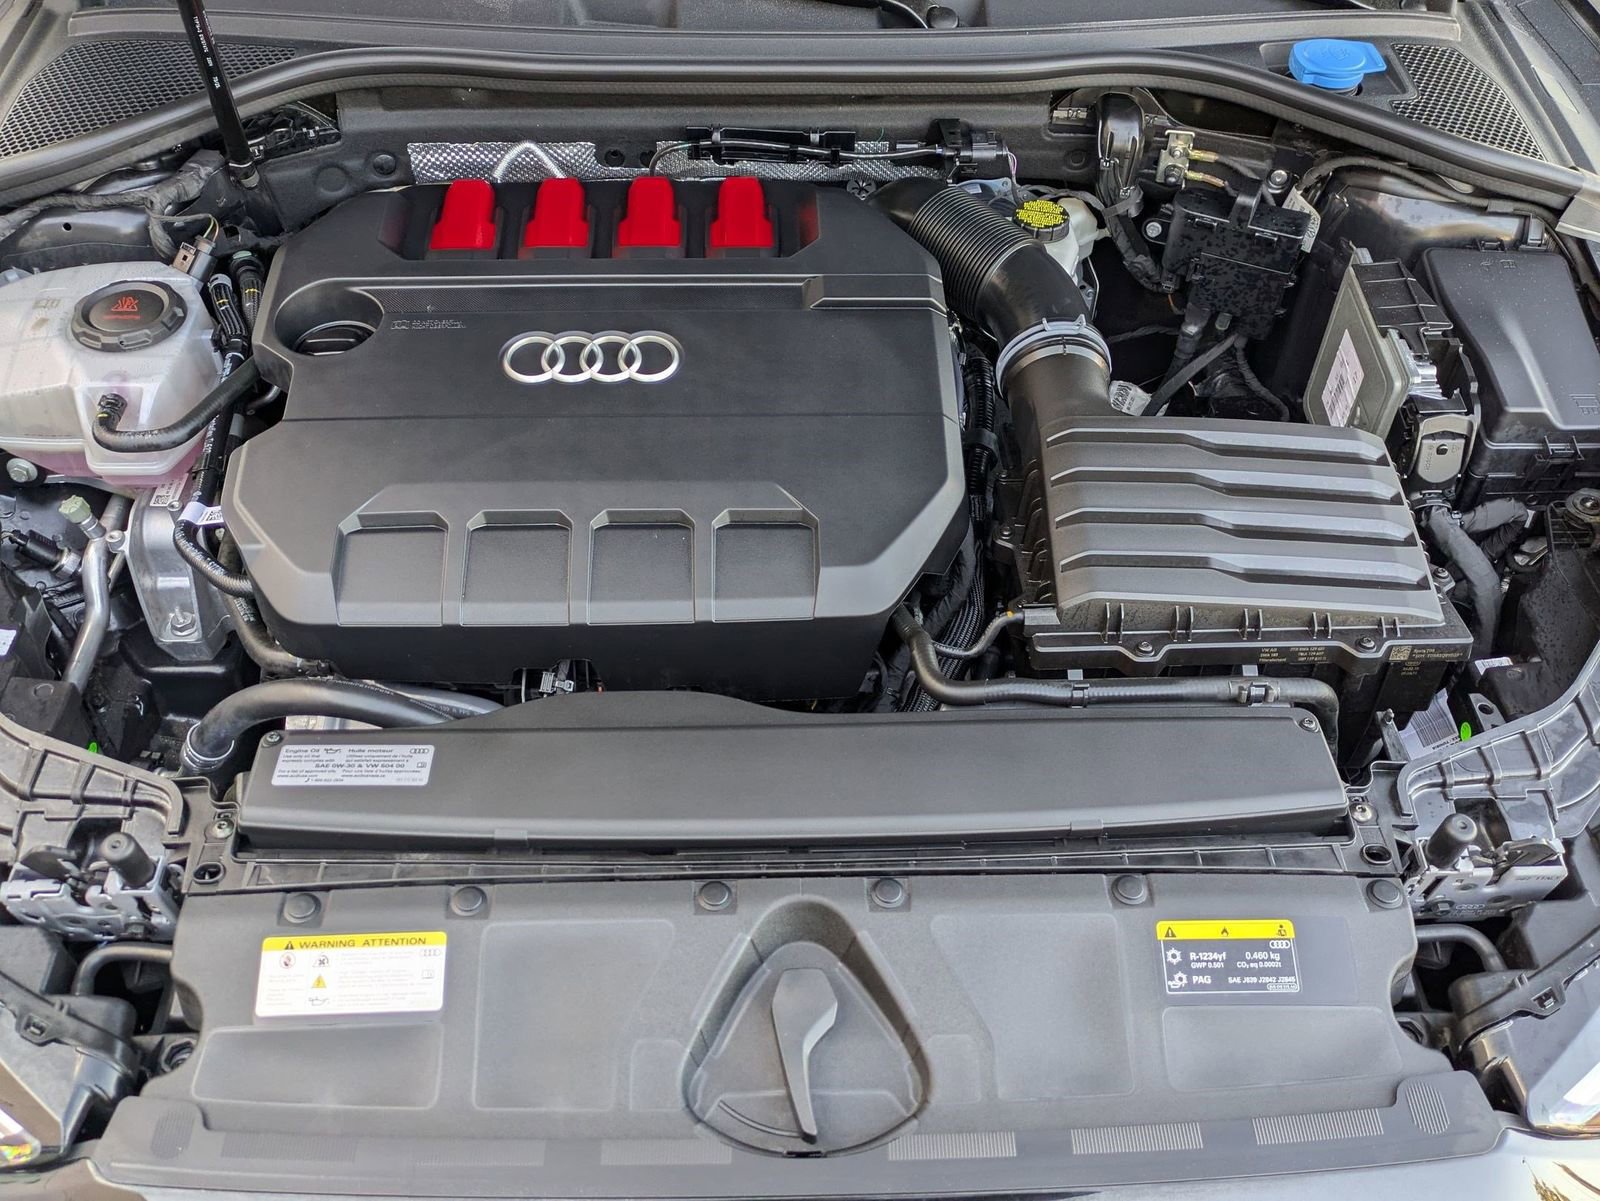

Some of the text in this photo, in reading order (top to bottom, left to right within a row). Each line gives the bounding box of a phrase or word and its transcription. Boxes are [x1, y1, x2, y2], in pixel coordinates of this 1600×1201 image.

[299, 938, 426, 949] WARNING ATTENTION
[1190, 952, 1226, 961] R-1234yf
[1245, 951, 1281, 961] 0.460 kg
[1192, 975, 1212, 984] PAG
